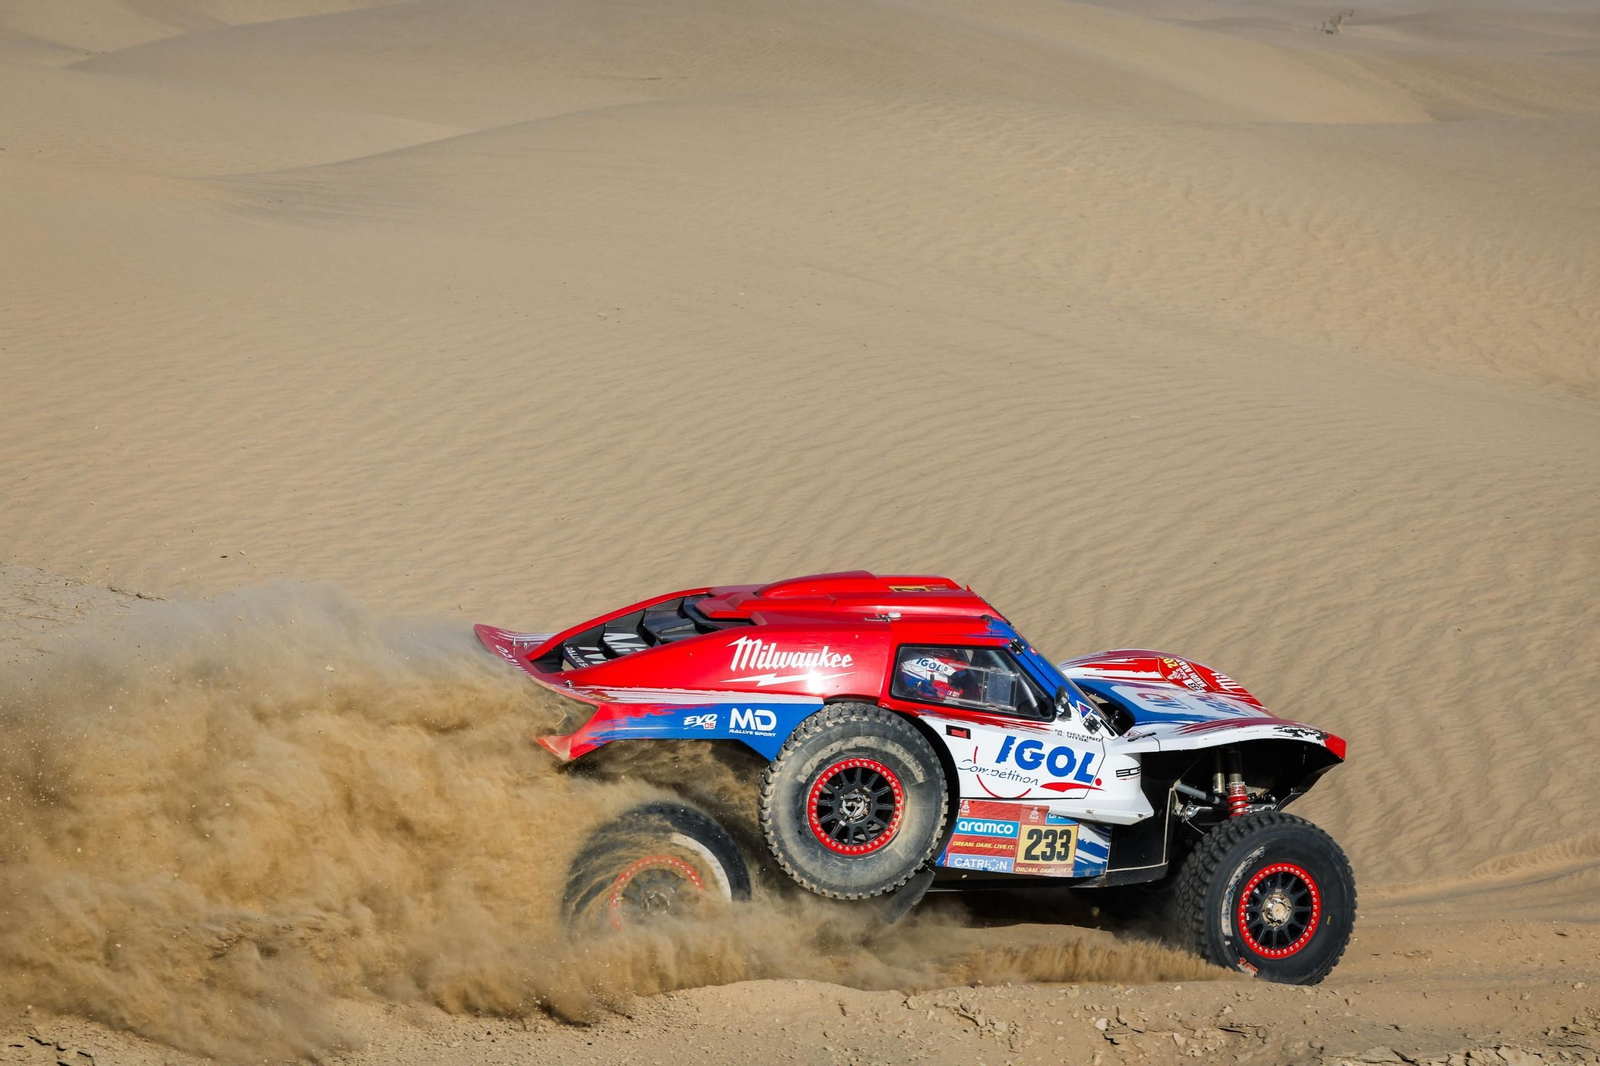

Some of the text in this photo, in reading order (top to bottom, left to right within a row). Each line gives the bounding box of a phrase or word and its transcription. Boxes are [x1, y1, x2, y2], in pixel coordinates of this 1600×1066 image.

[726, 635, 853, 672] Milwaukee
[916, 658, 943, 672] IGOL
[683, 713, 718, 727] EVO
[729, 708, 777, 731] MD
[995, 735, 1096, 784] IGOL
[958, 821, 1014, 835] aramco
[1024, 828, 1072, 862] 233
[954, 858, 1008, 870] CATRION
